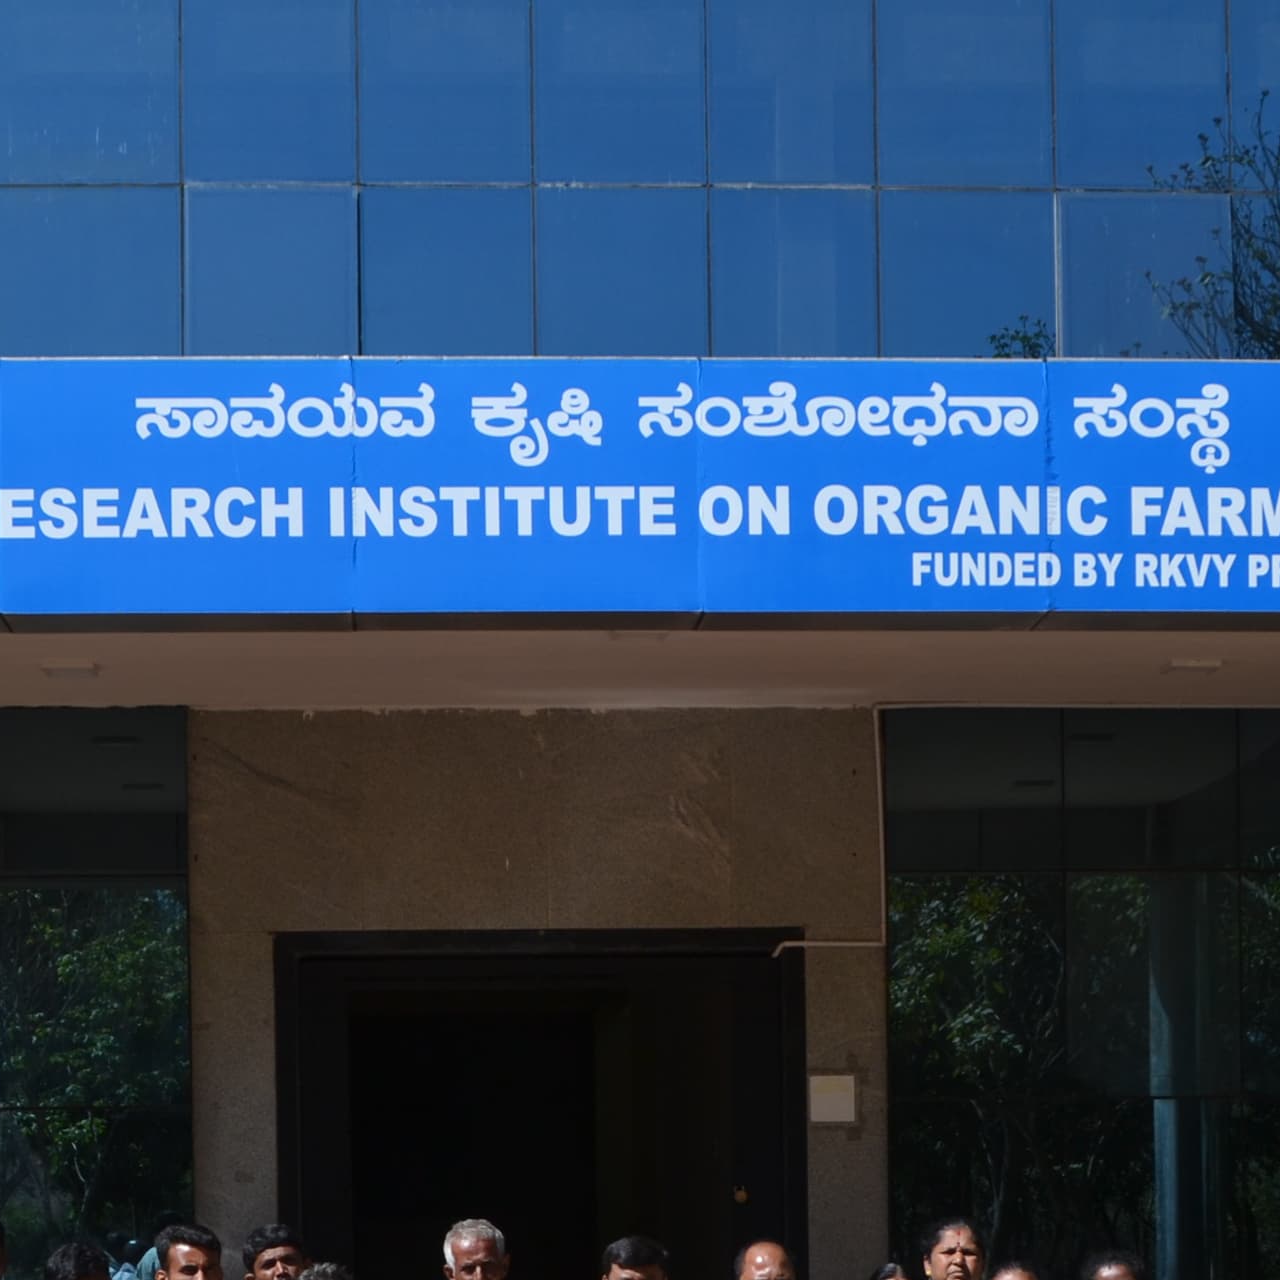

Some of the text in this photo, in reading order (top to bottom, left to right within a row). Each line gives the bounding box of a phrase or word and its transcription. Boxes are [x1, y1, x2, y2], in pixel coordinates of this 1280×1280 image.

[135, 381, 1230, 474] ಸಾವಯವ ಕೃಷಿ ಸಂಶೋಧನಾ ಸಂಸ್ಥೆ
[329, 486, 676, 537] INSTITUTE
[698, 485, 790, 536] ON
[814, 484, 1108, 536] ORGANIC
[912, 552, 1061, 586] FUNDED
[1074, 553, 1123, 587] BY
[1135, 553, 1236, 587] RKVY
